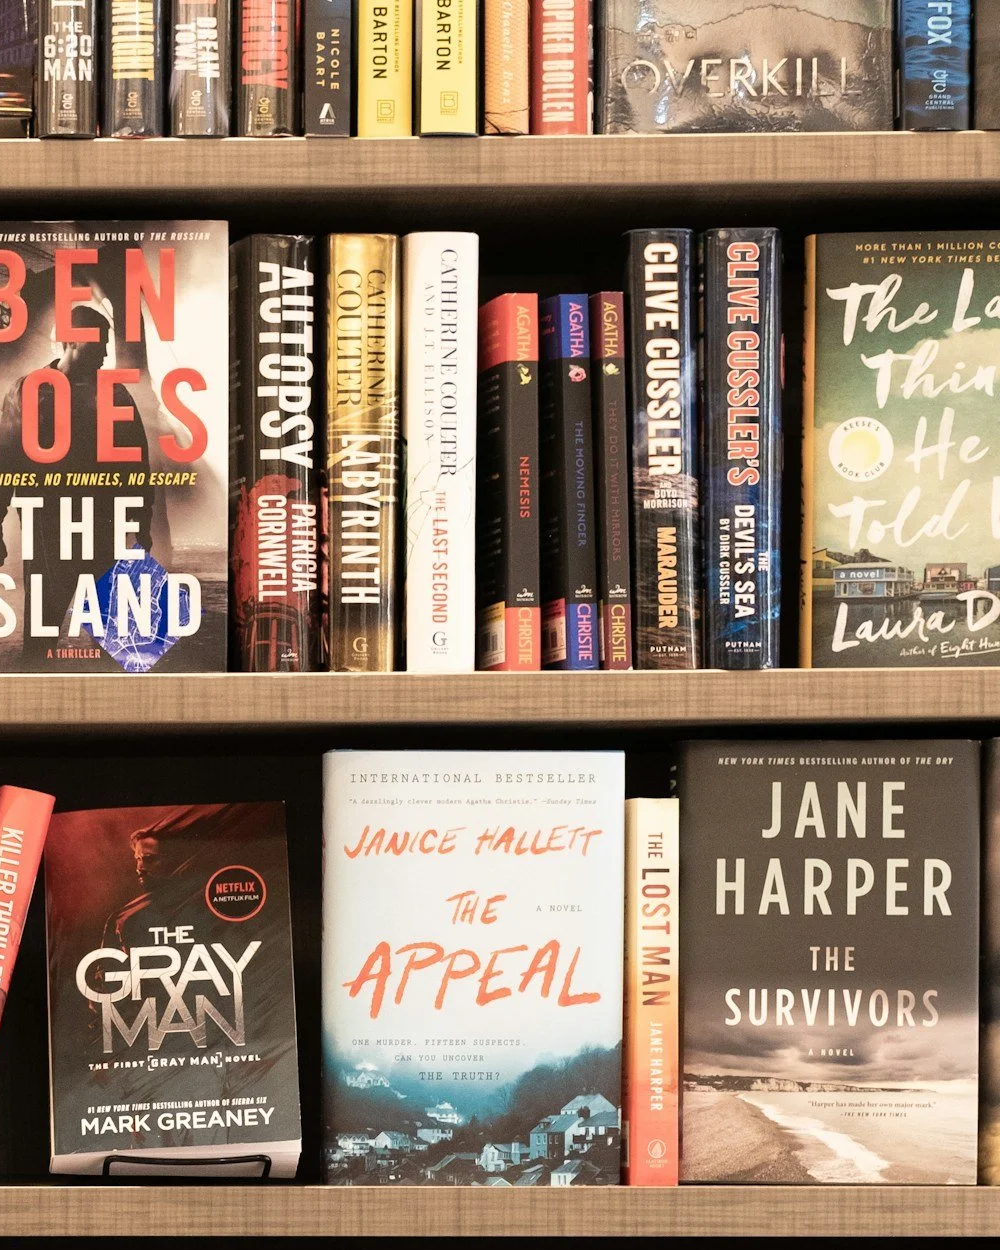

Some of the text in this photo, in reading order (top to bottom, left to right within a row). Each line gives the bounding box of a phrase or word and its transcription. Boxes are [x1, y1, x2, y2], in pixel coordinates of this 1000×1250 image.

[53, 21, 83, 36] THE
[373, 7, 388, 79] BARTON
[927, 2, 953, 45] FOX
[44, 36, 92, 59] 6:20
[44, 59, 92, 82] MAN
[620, 57, 862, 98] OVERKILL
[259, 262, 314, 469] AUTOPSY
[643, 242, 680, 476] CLIVE CUSSLER
[44, 472, 62, 486] NO
[66, 472, 123, 487] TUNNELS,
[129, 472, 145, 486] NO
[149, 471, 197, 486] ESCAPE
[519, 456, 530, 518] NEMESIS
[18, 496, 145, 561] THE
[258, 495, 285, 603] CORNWELL
[291, 504, 316, 593] PATRICIA
[655, 526, 678, 629] MARAUDER
[46, 647, 101, 658] A THRILLER
[351, 773, 596, 784] INTERNATIONAL BESTSELLER
[762, 781, 905, 840] JANE
[344, 824, 602, 859] JANICE HALLETT
[216, 881, 255, 894] NETFLIX
[446, 889, 507, 925] THE
[715, 858, 953, 916] HARPER
[342, 939, 602, 1020] APPEAL
[809, 947, 856, 972] THE
[724, 988, 939, 1027] SURVIVORS
[81, 1108, 275, 1135] MARK GREANEY
